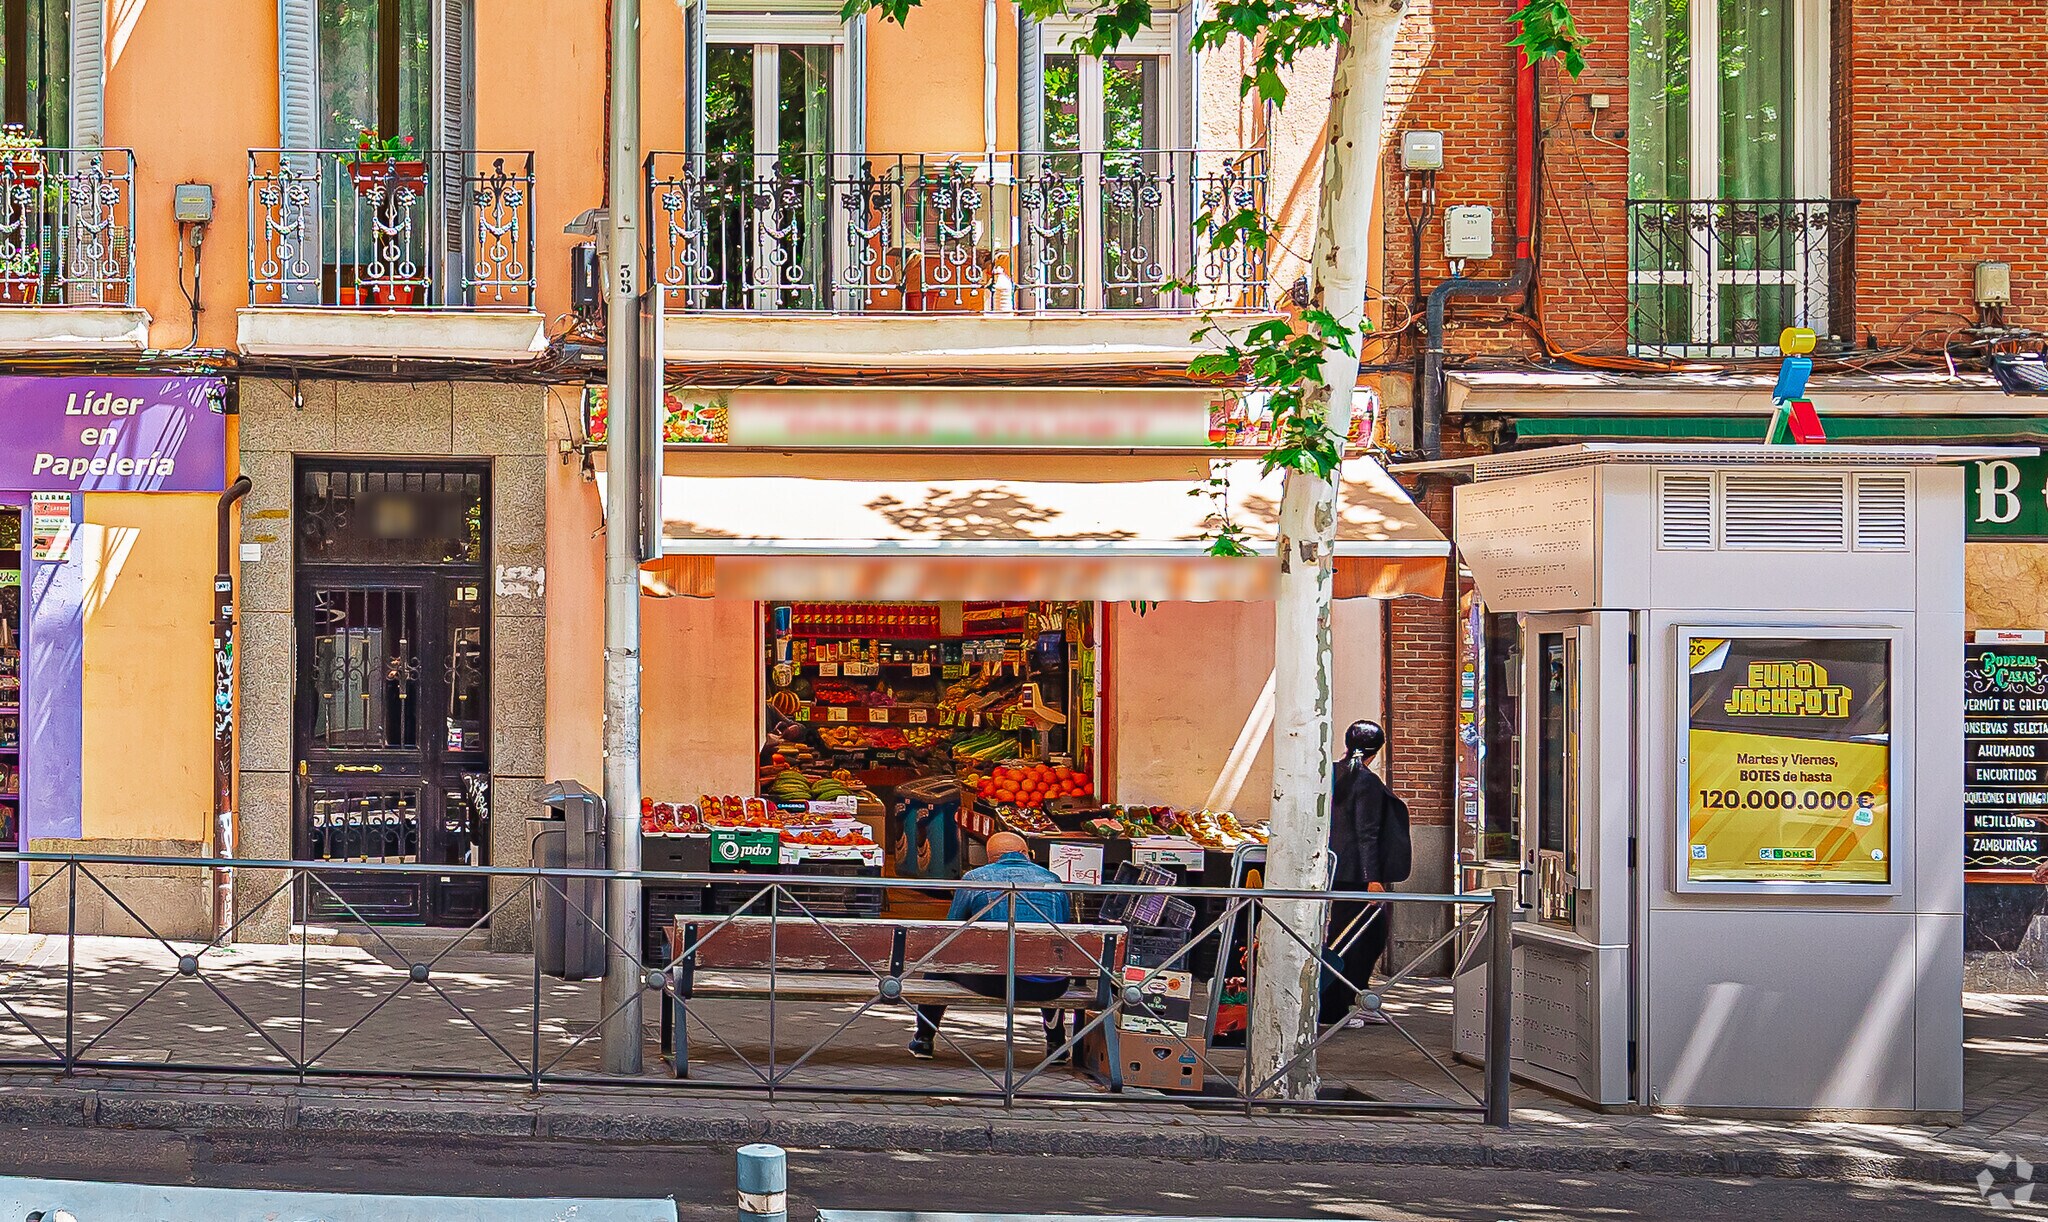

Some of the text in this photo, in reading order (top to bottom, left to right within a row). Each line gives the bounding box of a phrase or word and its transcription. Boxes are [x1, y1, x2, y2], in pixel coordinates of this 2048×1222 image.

[65, 391, 144, 415] Líder
[80, 426, 118, 446] en
[32, 451, 175, 481] Papelería
[1690, 645, 1705, 655] 2€
[1980, 652, 2038, 677] BODEGAS
[1749, 664, 1815, 688] EURO
[1995, 668, 2037, 688] CASAS
[1724, 688, 1840, 714] JACKPOT
[2003, 699, 2016, 711] DE
[2019, 699, 2048, 711] GRIFO
[1963, 722, 2048, 734] ONSERVAS SELECTA
[1978, 745, 2035, 758] AHUMADOS
[1737, 753, 1838, 768] Martes y Viernes,
[1740, 770, 1832, 782] BOTES de hasta
[1976, 769, 2037, 781] ENCURTIDOS
[1963, 792, 2004, 805] OQUERONES
[2017, 792, 2048, 805] VINAGR
[1973, 837, 2038, 852] ZAMBURIÑAS
[1784, 850, 1814, 858] ONCE
